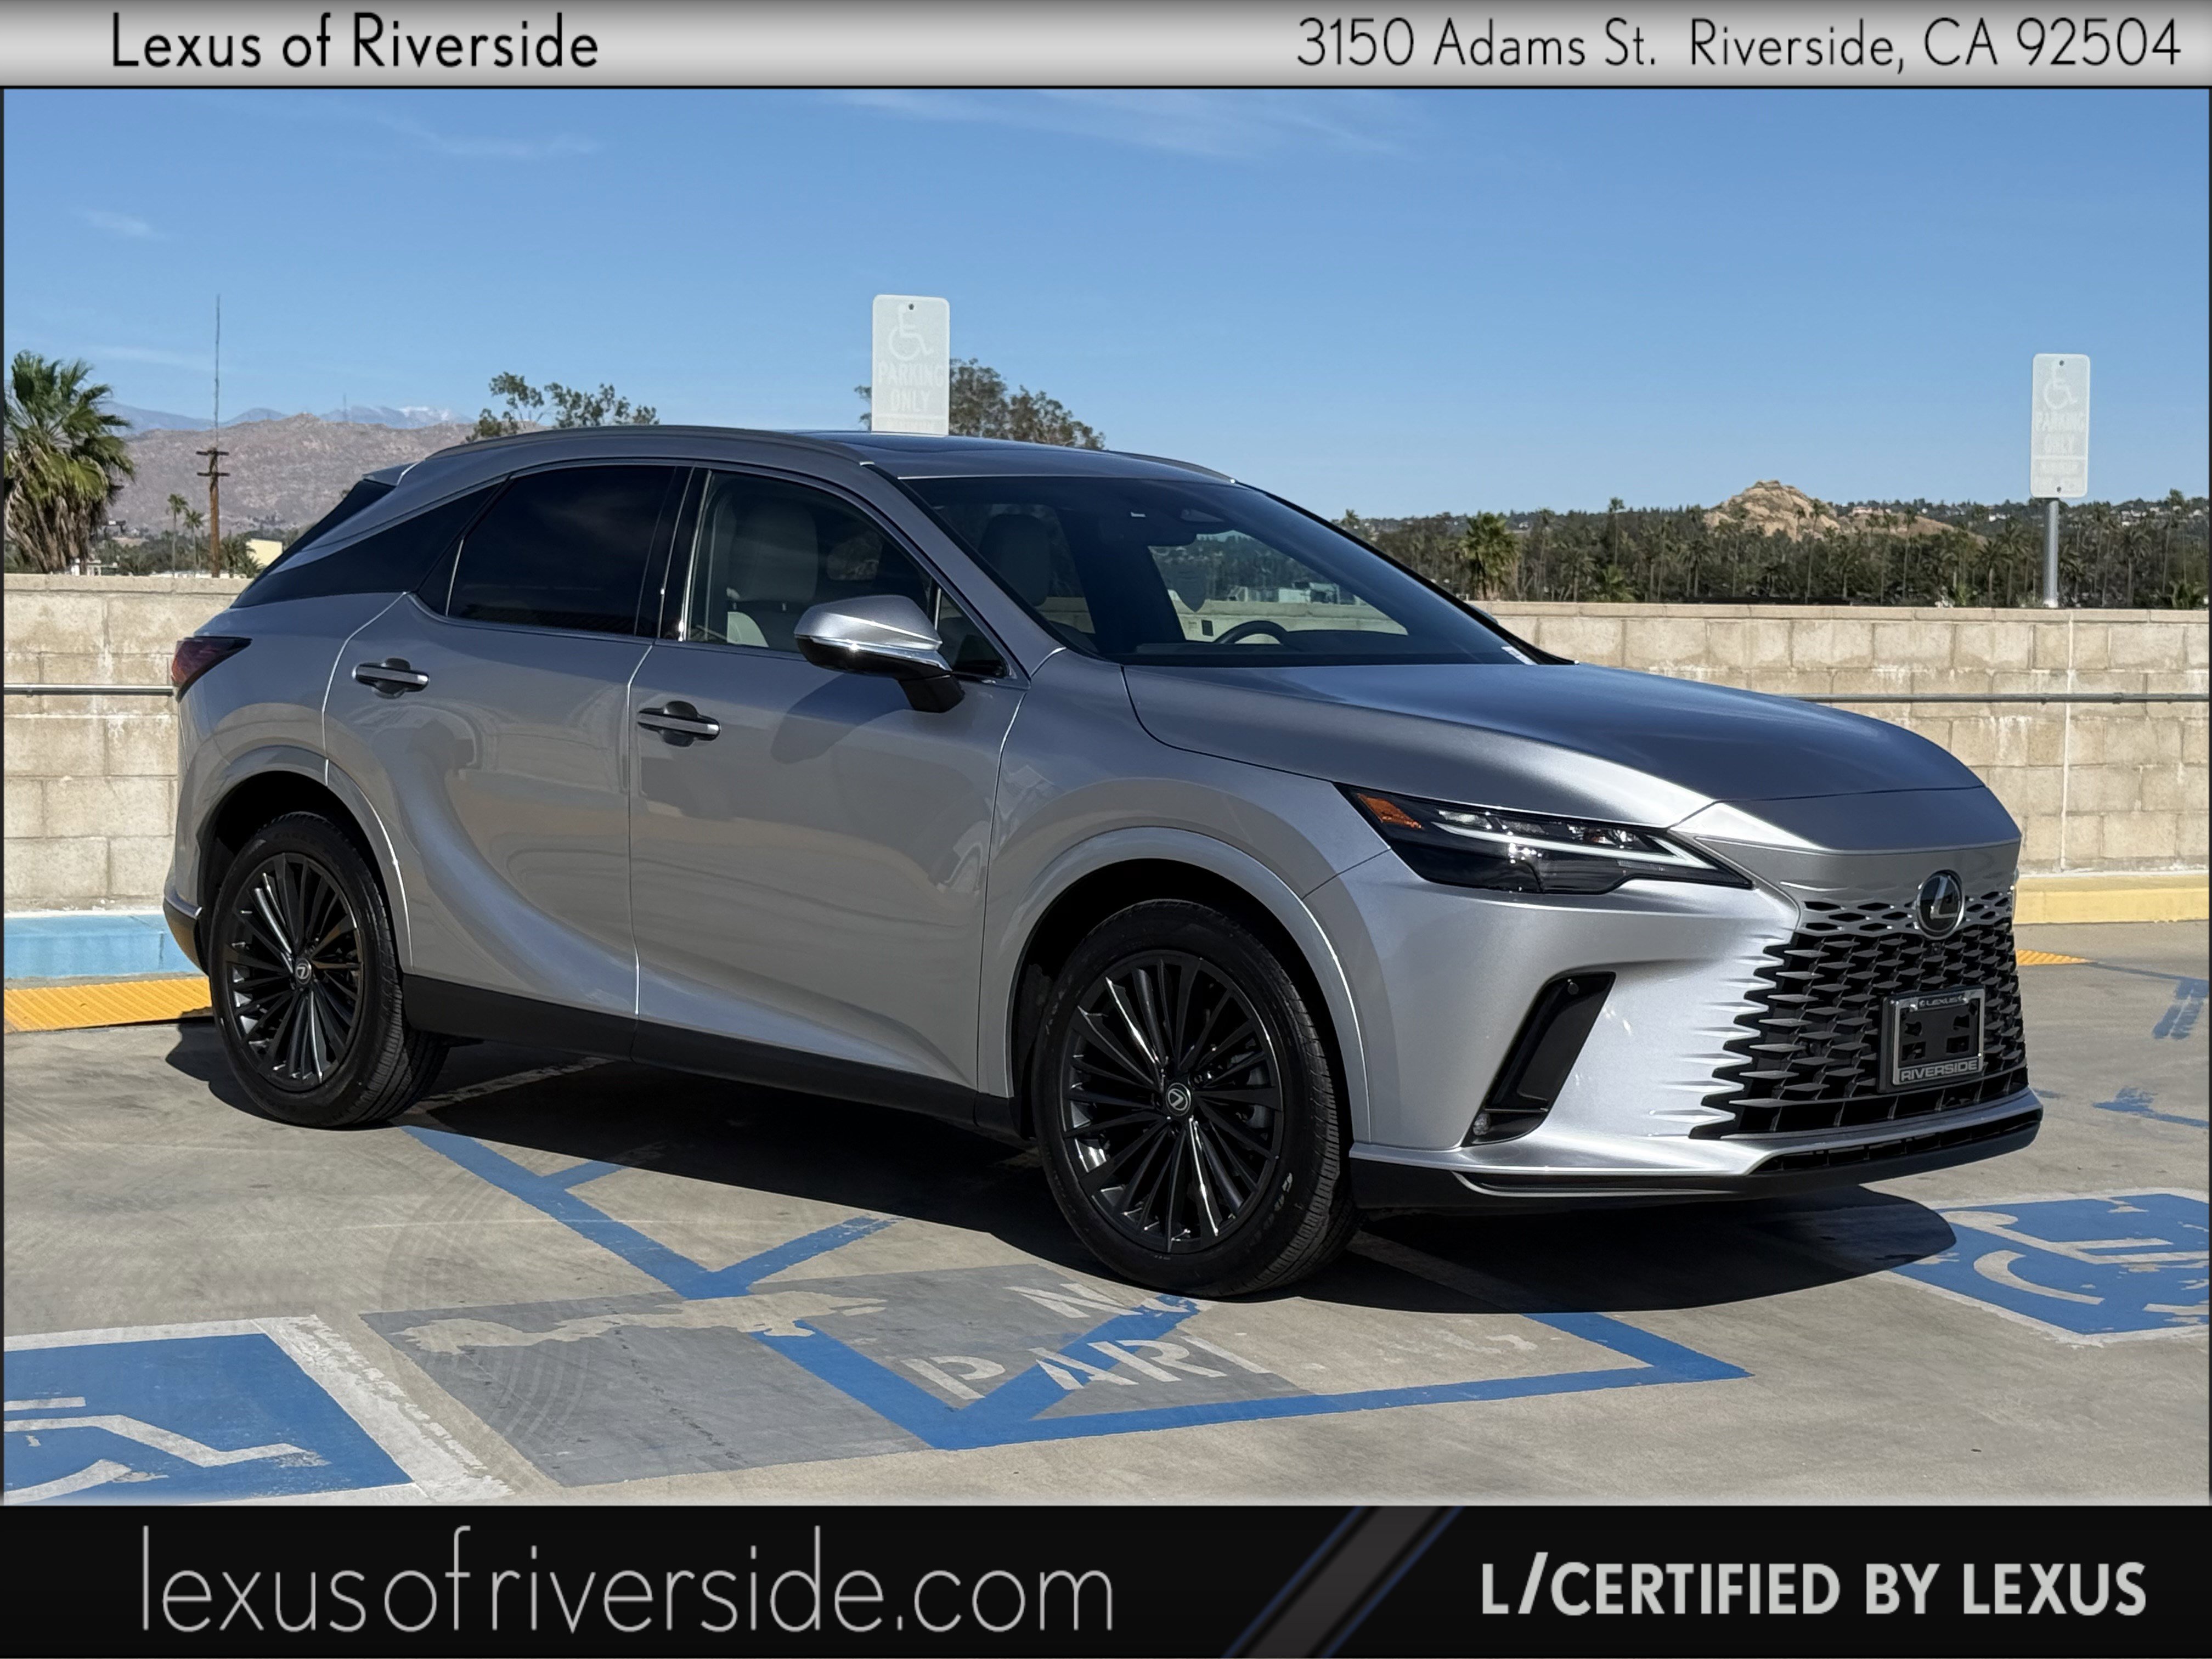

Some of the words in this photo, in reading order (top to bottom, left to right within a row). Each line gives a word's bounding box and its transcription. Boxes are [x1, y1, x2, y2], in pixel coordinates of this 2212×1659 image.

[878, 360, 944, 387] PARKING
[890, 388, 931, 413] ONLY
[1901, 1059, 1978, 1082] RIVERSIDE
